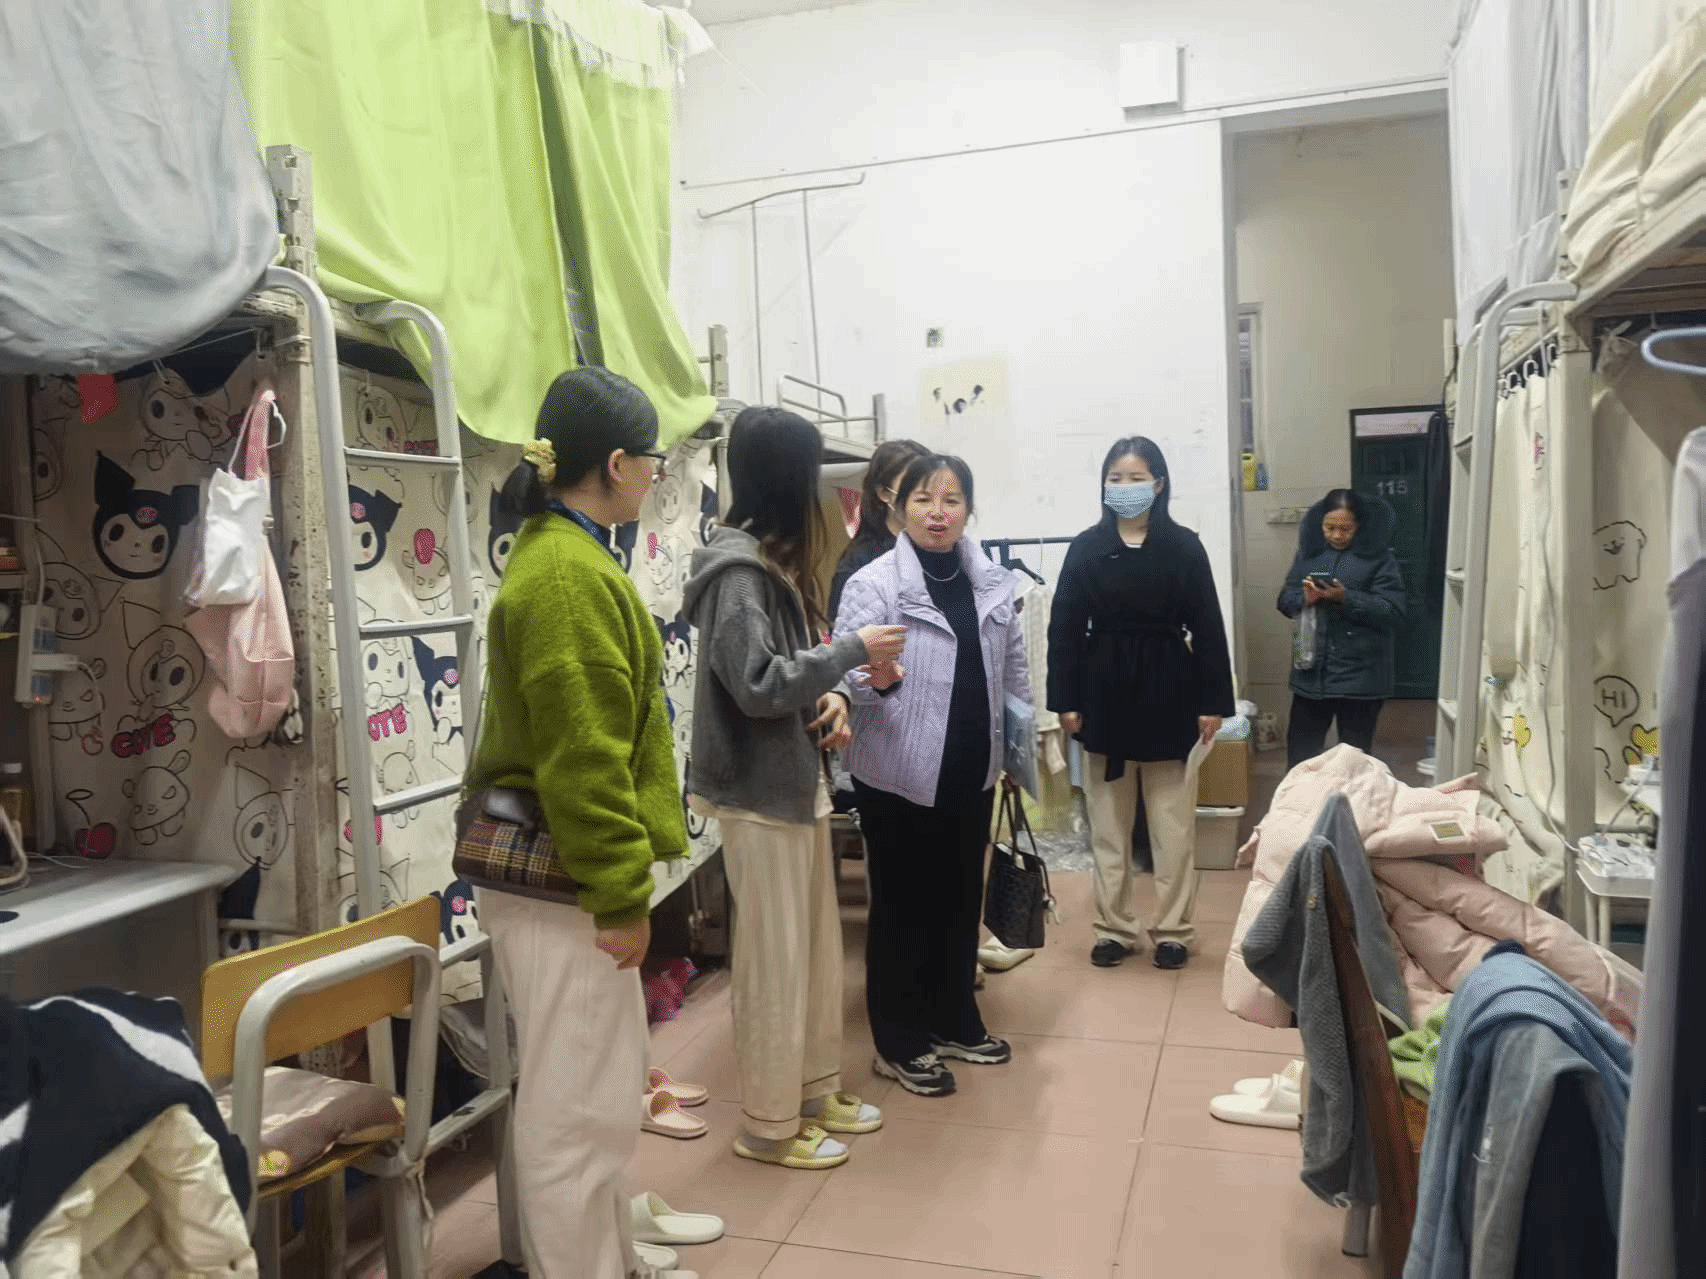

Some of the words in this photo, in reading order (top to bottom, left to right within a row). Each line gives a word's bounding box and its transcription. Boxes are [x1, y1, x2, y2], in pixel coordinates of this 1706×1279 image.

[1601, 688, 1627, 709] HI
[110, 713, 176, 758] CUTE
[367, 703, 408, 741] UTE
